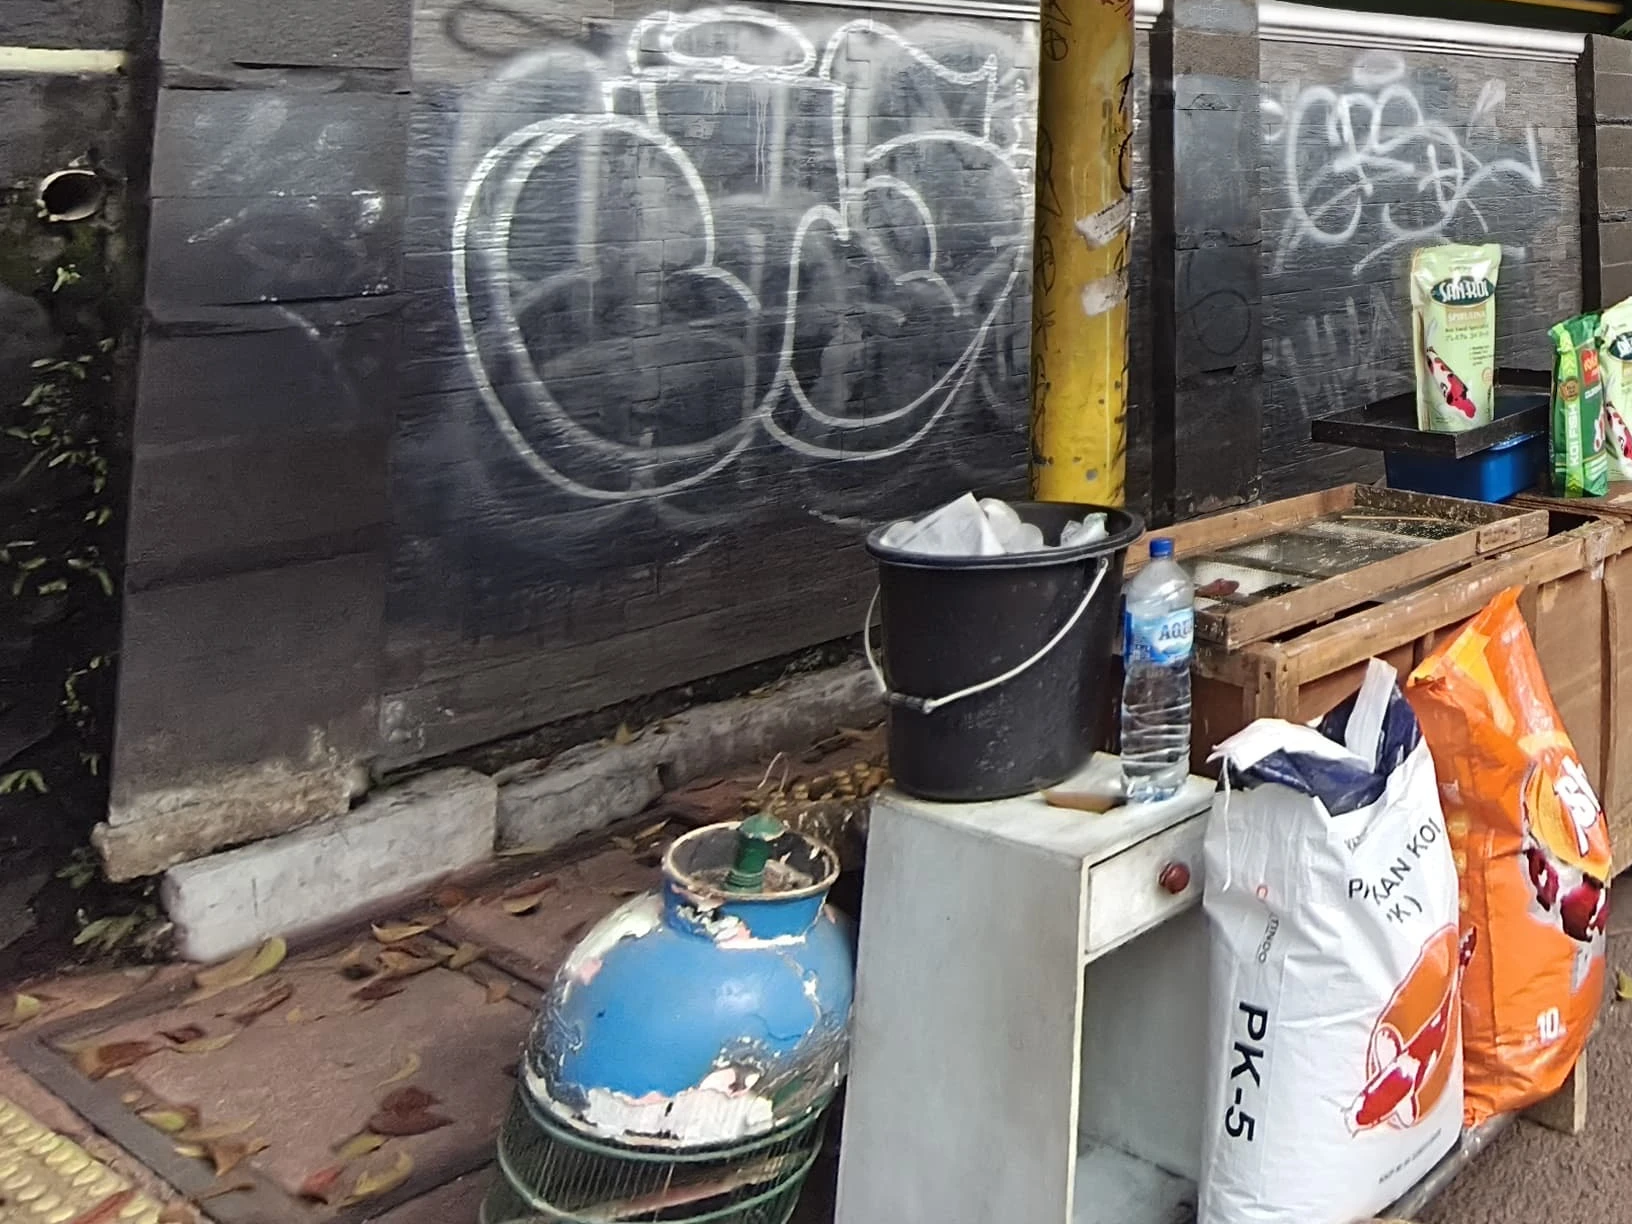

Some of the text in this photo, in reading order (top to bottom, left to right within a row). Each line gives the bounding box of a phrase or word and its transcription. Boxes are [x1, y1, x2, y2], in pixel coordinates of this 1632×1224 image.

[1158, 617, 1194, 641] AQU
[1349, 857, 1411, 906] PKAN
[1406, 817, 1441, 858] KOI
[1225, 1001, 1268, 1141] PK-5
